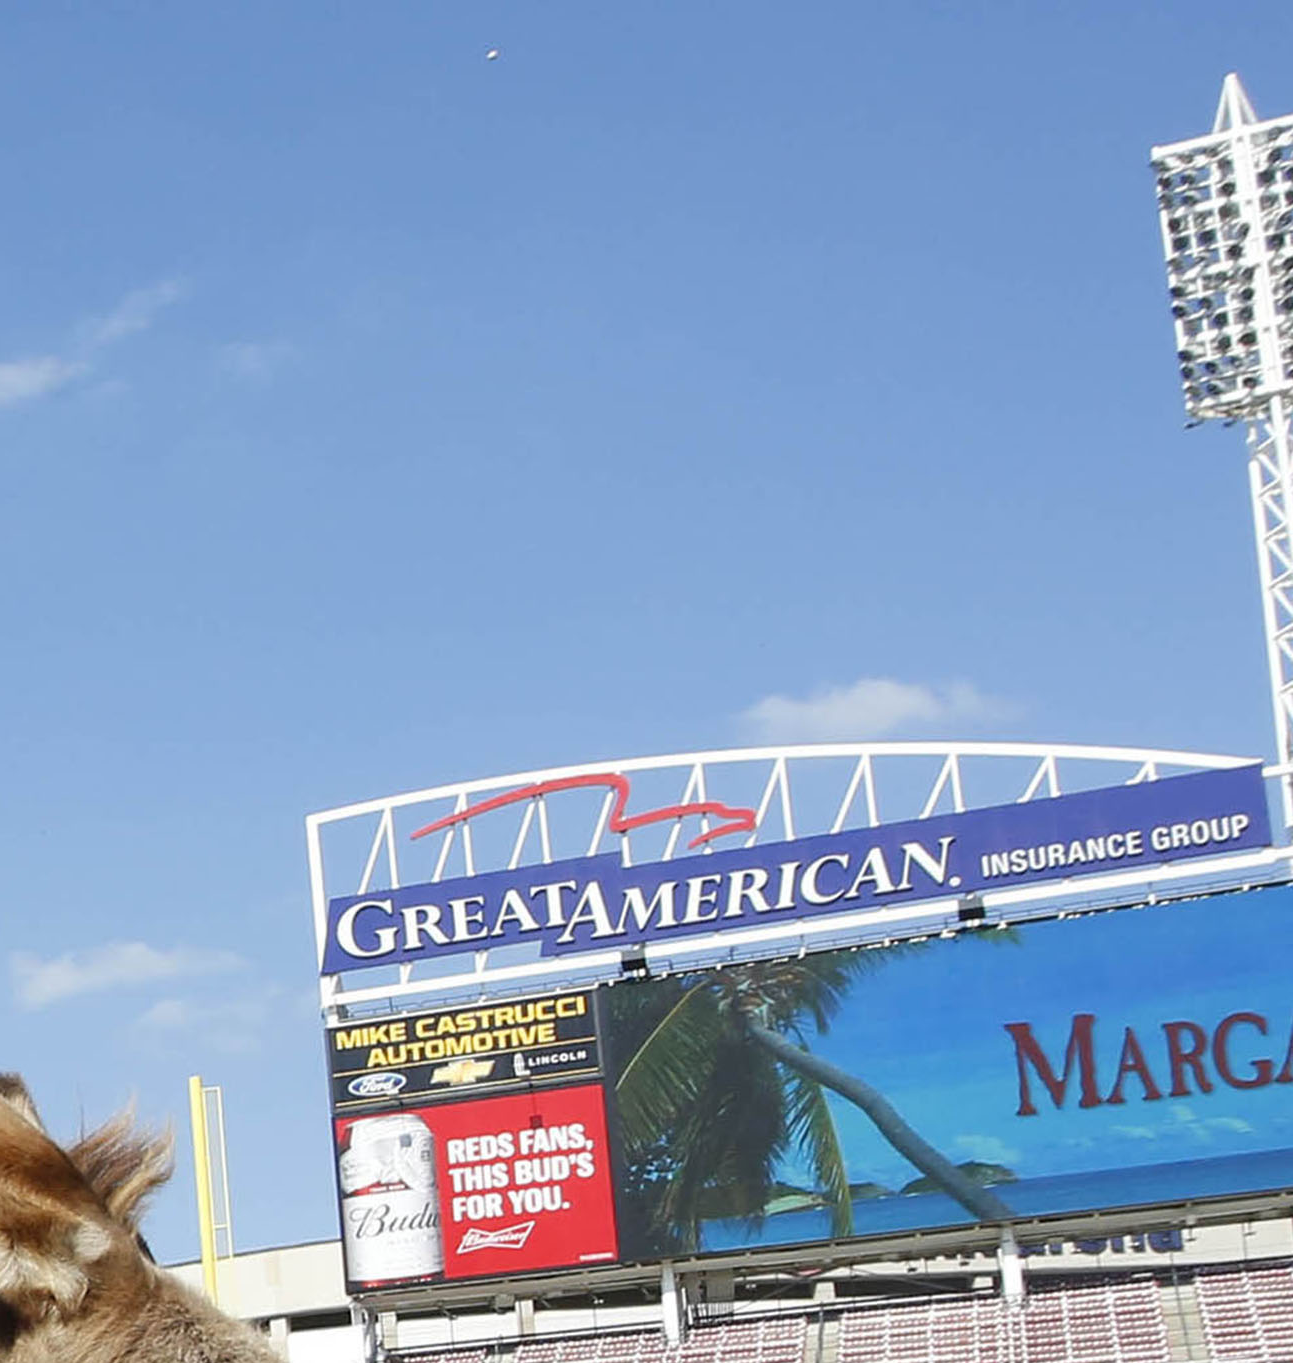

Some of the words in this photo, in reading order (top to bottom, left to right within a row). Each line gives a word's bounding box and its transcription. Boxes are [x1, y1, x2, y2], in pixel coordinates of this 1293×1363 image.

[980, 831, 1143, 878] INSURANCE
[1151, 814, 1250, 850] GROUP
[335, 1022, 407, 1051] MIKE
[415, 995, 587, 1038] CASTRUCCI
[367, 1023, 557, 1067] AUTOMOTIVE
[528, 1050, 587, 1067] LINCOLN
[1003, 1010, 1293, 1116] MARG
[360, 1076, 396, 1094] Ford
[447, 1132, 515, 1164] REDS
[519, 1123, 594, 1155] FANS,
[448, 1164, 510, 1192] THIS
[515, 1153, 595, 1185] BUD'S
[451, 1192, 504, 1222] FOR
[508, 1187, 571, 1215] YOU.
